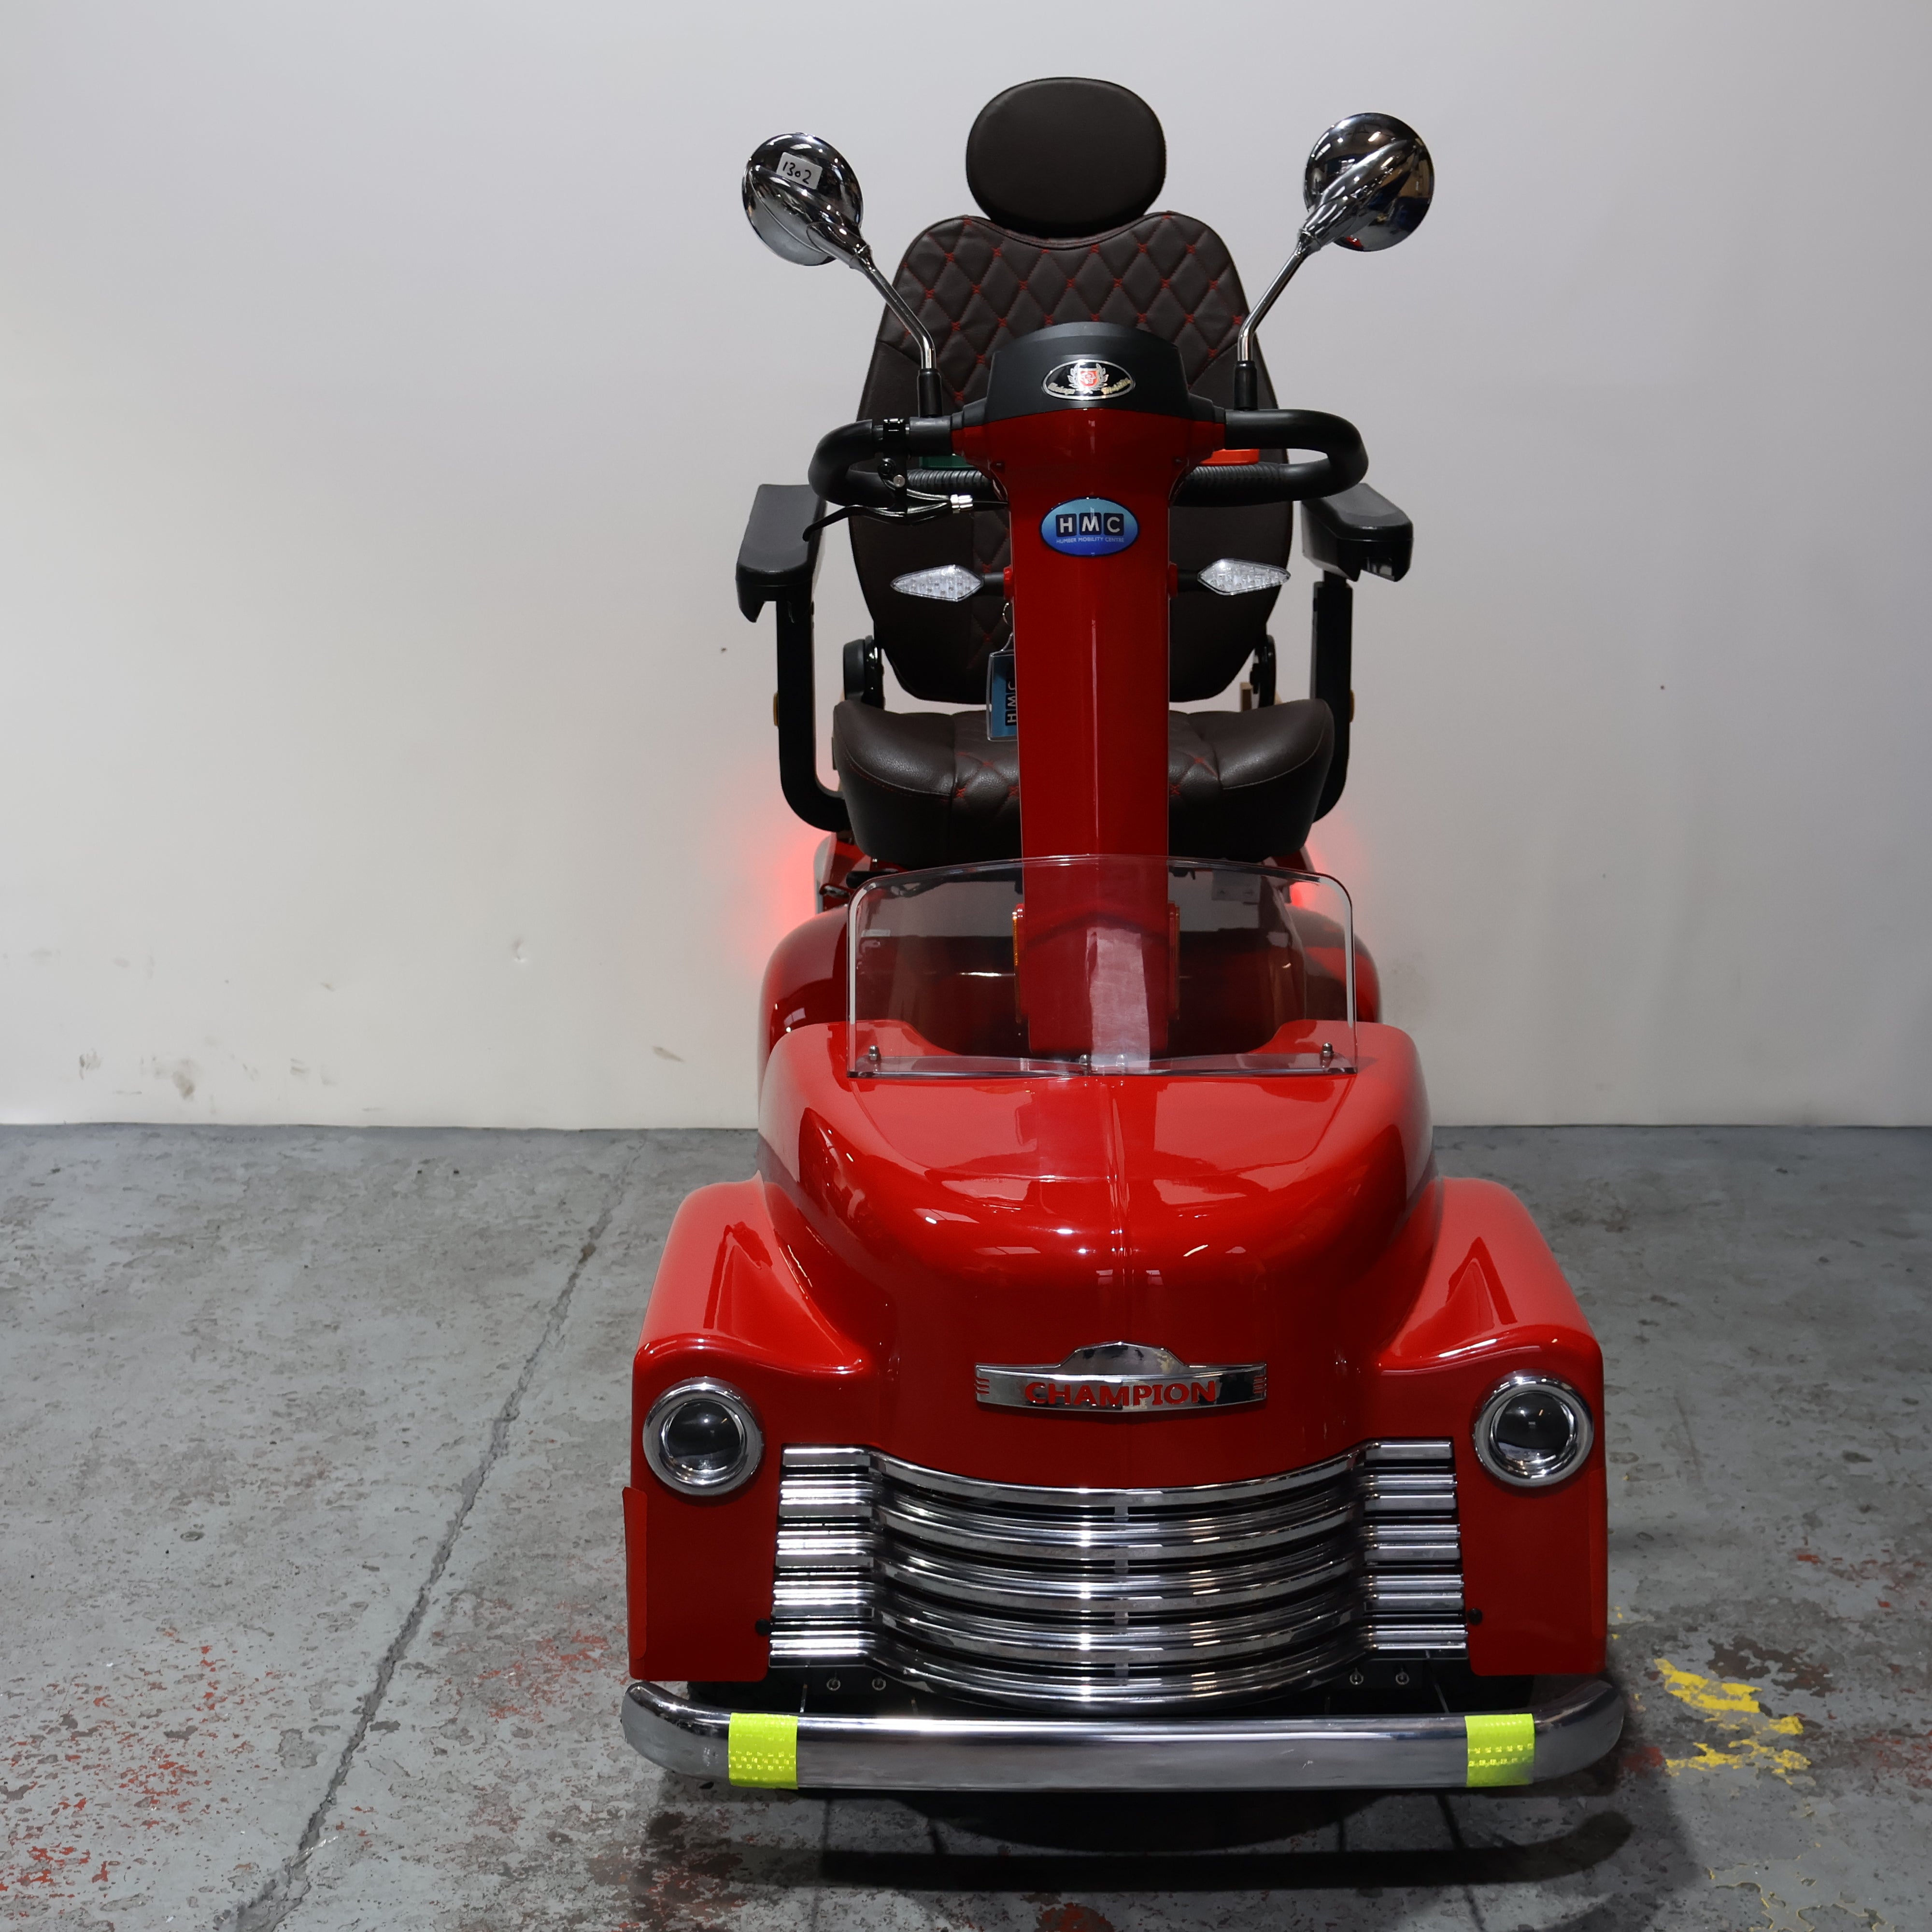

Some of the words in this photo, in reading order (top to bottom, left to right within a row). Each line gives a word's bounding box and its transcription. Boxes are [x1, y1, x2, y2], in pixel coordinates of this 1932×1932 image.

[782, 161, 811, 185] 1302
[1060, 516, 1120, 533] HMC
[1025, 1381, 1216, 1406] CHAMPION
